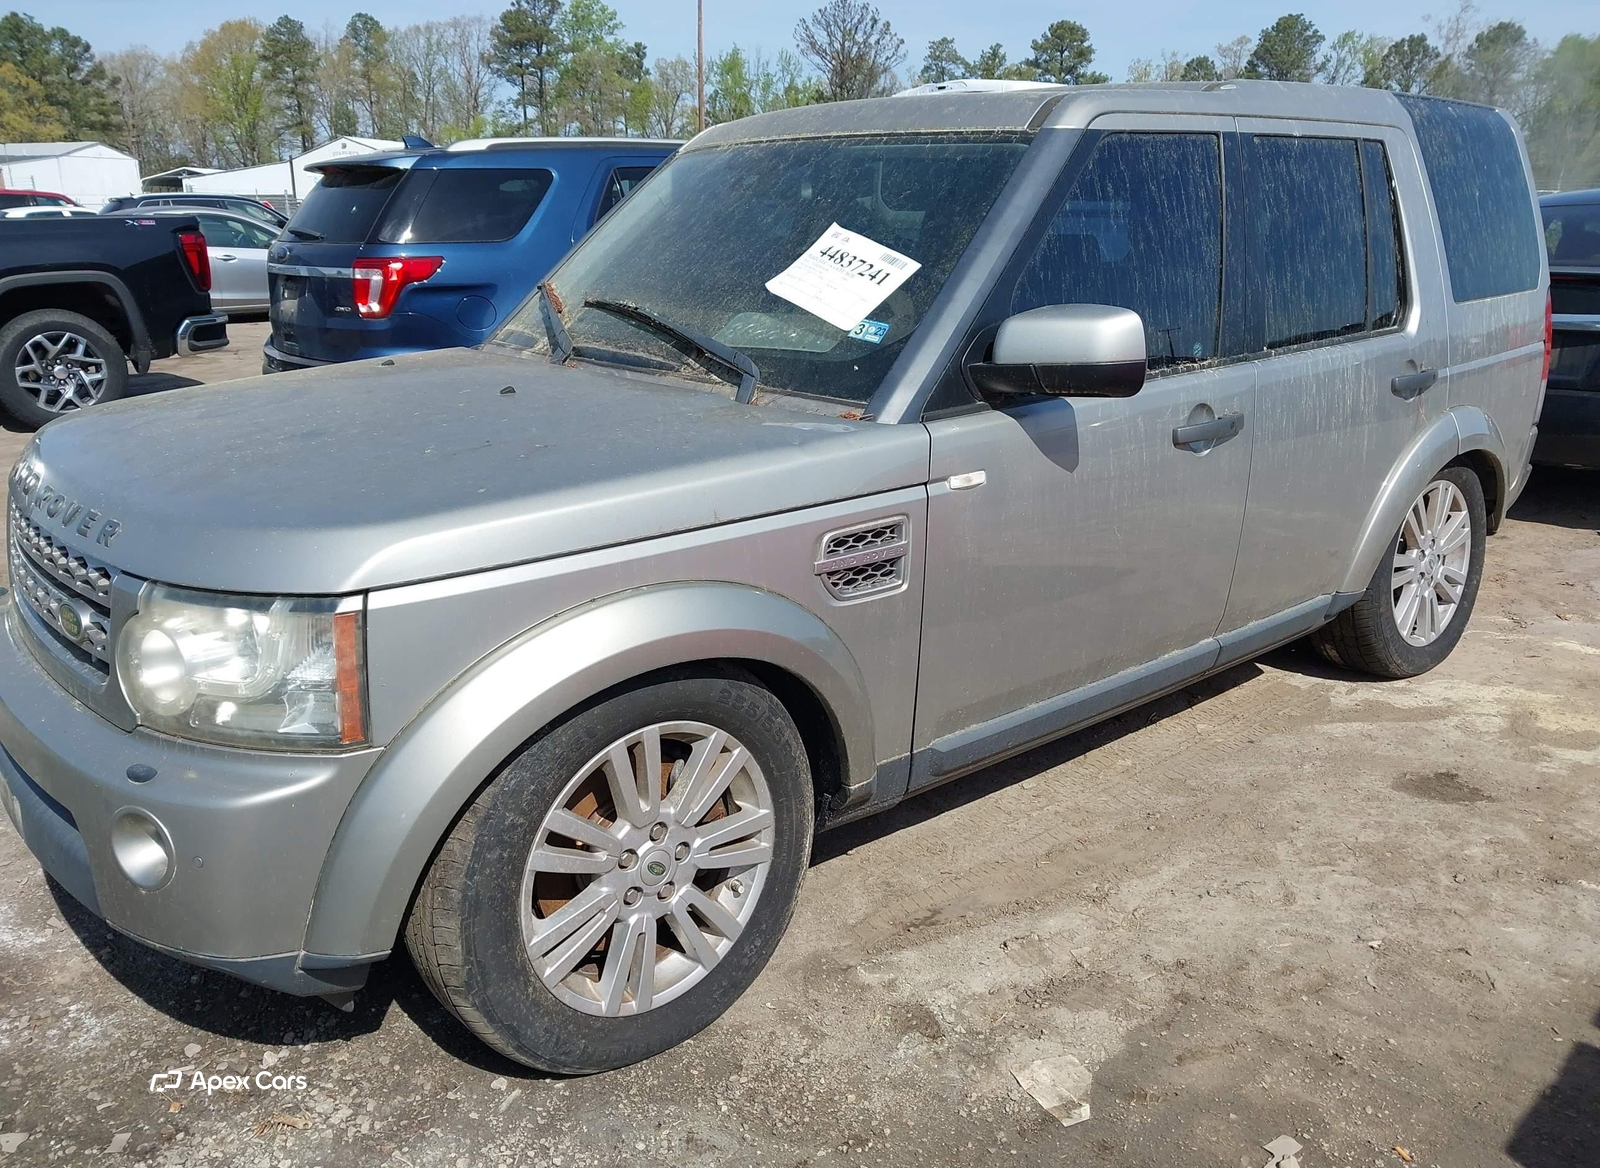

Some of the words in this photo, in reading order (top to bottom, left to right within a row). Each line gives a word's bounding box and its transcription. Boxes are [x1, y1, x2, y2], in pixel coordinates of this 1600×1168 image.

[819, 245, 891, 286] 44837241
[855, 323, 866, 335] 3
[874, 326, 887, 337] 23
[34, 484, 122, 549] ROVER
[822, 557, 857, 571] LAND
[863, 546, 904, 563] ROVER
